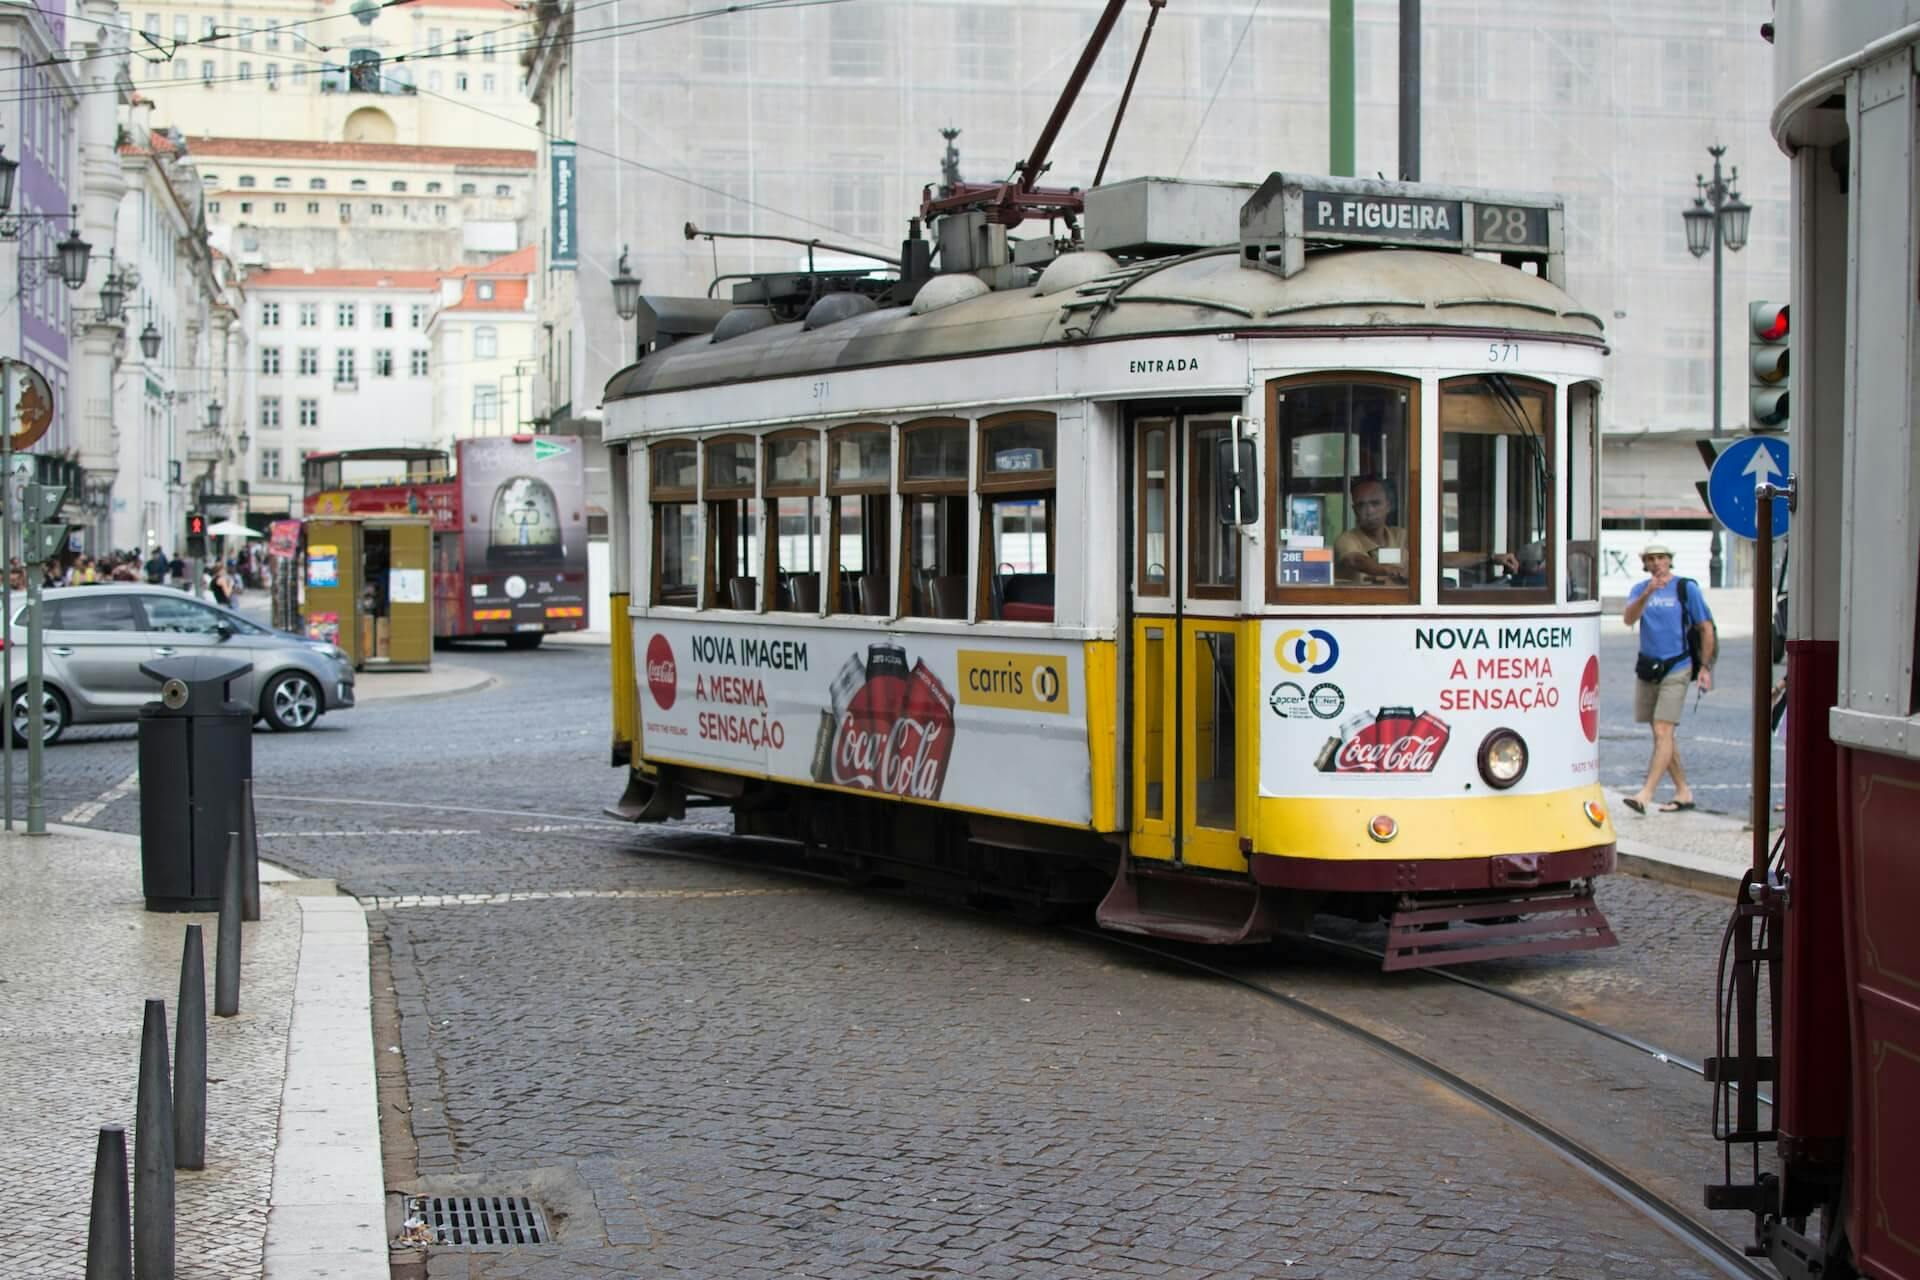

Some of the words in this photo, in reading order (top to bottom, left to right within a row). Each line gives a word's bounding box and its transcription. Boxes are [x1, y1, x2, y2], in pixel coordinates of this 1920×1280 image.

[1317, 200, 1335, 227] P.
[1343, 201, 1450, 231] FIGUEIRA
[1482, 207, 1527, 244] 28
[1130, 357, 1199, 374] ENTRADA
[1488, 343, 1520, 363] 571
[812, 381, 830, 399] 571
[1282, 552, 1302, 562] 28E
[1282, 569, 1300, 582] 11
[1415, 628, 1490, 649] NOVA
[1499, 627, 1572, 649] IMAGEM
[692, 635, 737, 665] NOVA
[741, 639, 809, 671] IMAGEM
[969, 660, 1023, 695] carris
[1450, 658, 1468, 680] A
[1477, 657, 1552, 679] MESMA
[696, 673, 707, 701] A
[710, 675, 768, 708] MESMA
[1440, 682, 1560, 713] SENSAÇÃO
[698, 711, 785, 751] SENSAÇÃO
